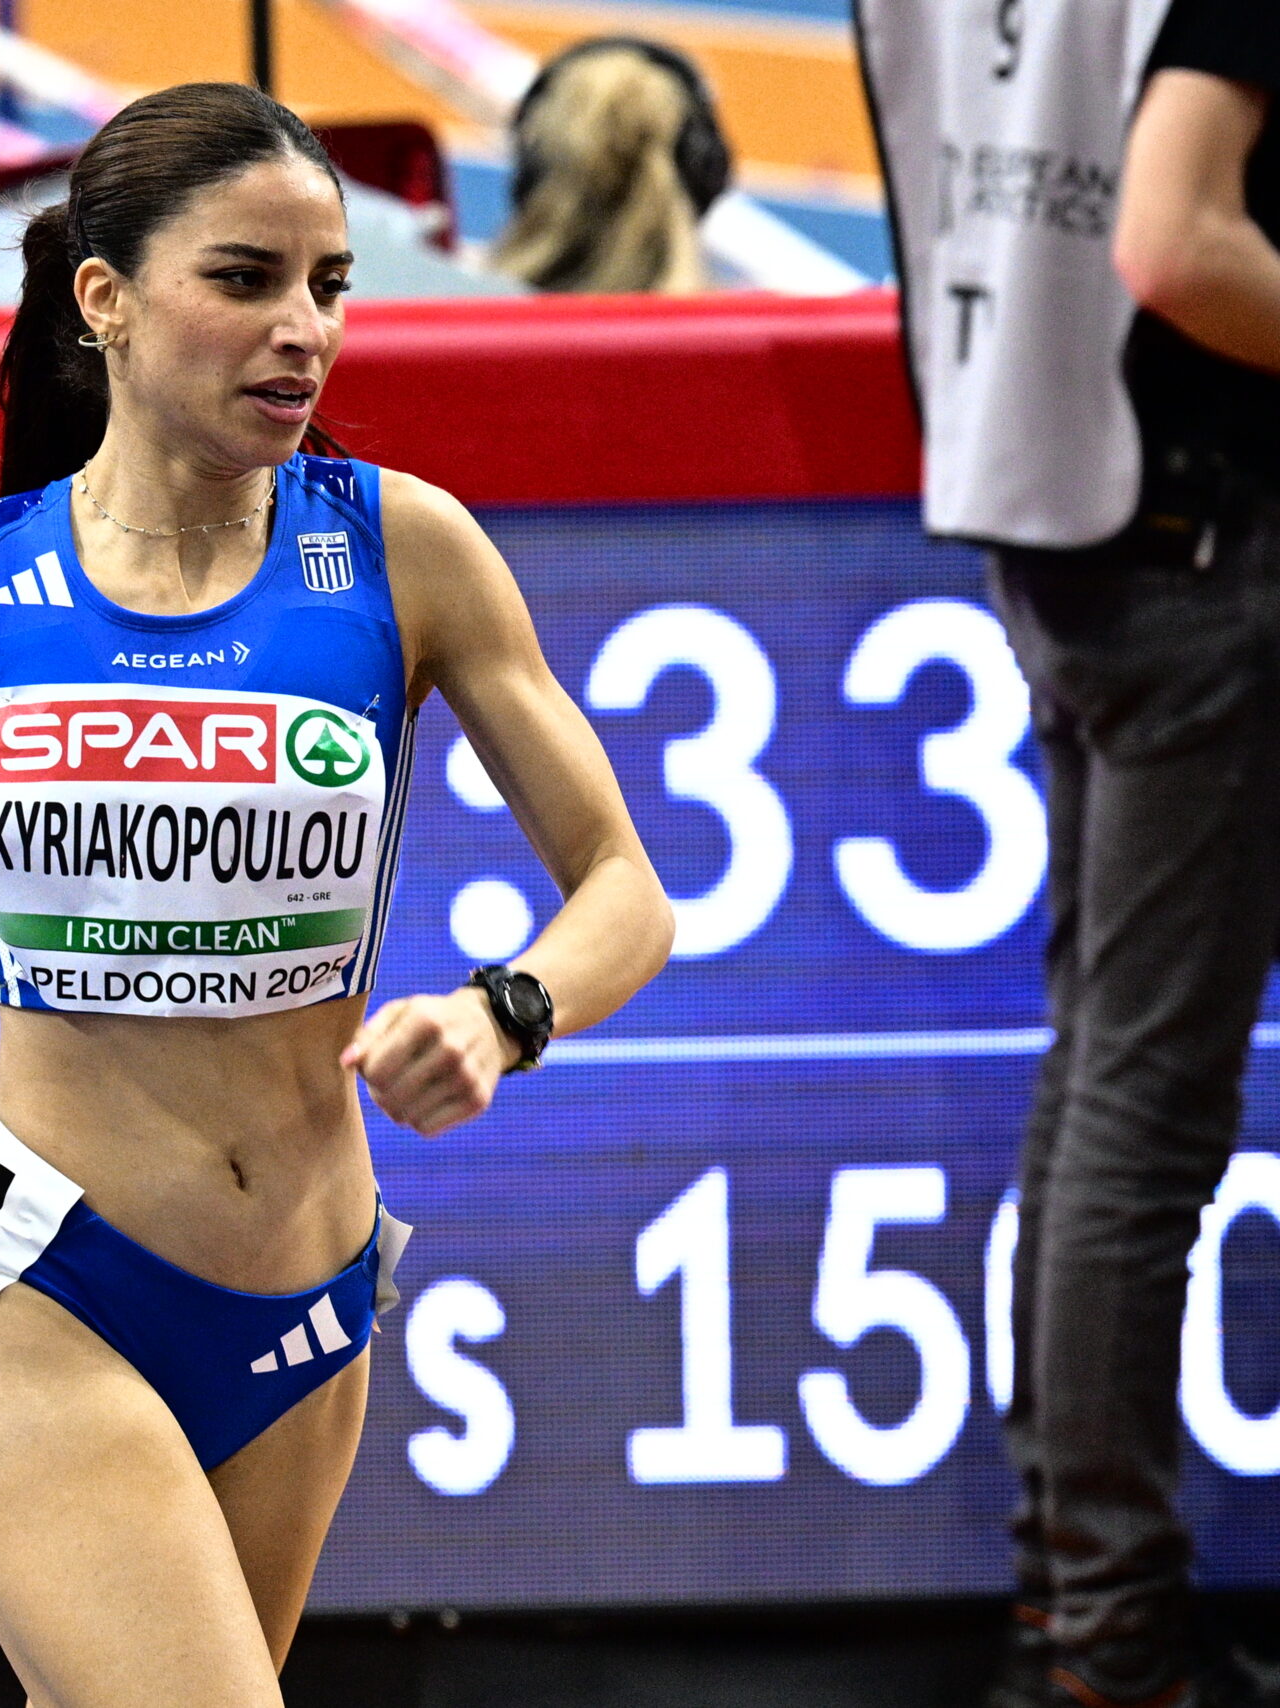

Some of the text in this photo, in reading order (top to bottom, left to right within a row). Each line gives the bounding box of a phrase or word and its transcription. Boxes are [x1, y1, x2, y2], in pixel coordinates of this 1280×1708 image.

[112, 650, 225, 668] AEGEAN
[0, 711, 268, 771] SPAR
[287, 893, 304, 902] 642
[312, 892, 331, 901] GRE
[66, 921, 73, 946] I
[82, 922, 158, 950] RUN
[31, 966, 256, 1004] PELDOORN
[626, 1151, 1280, 1487] 150
